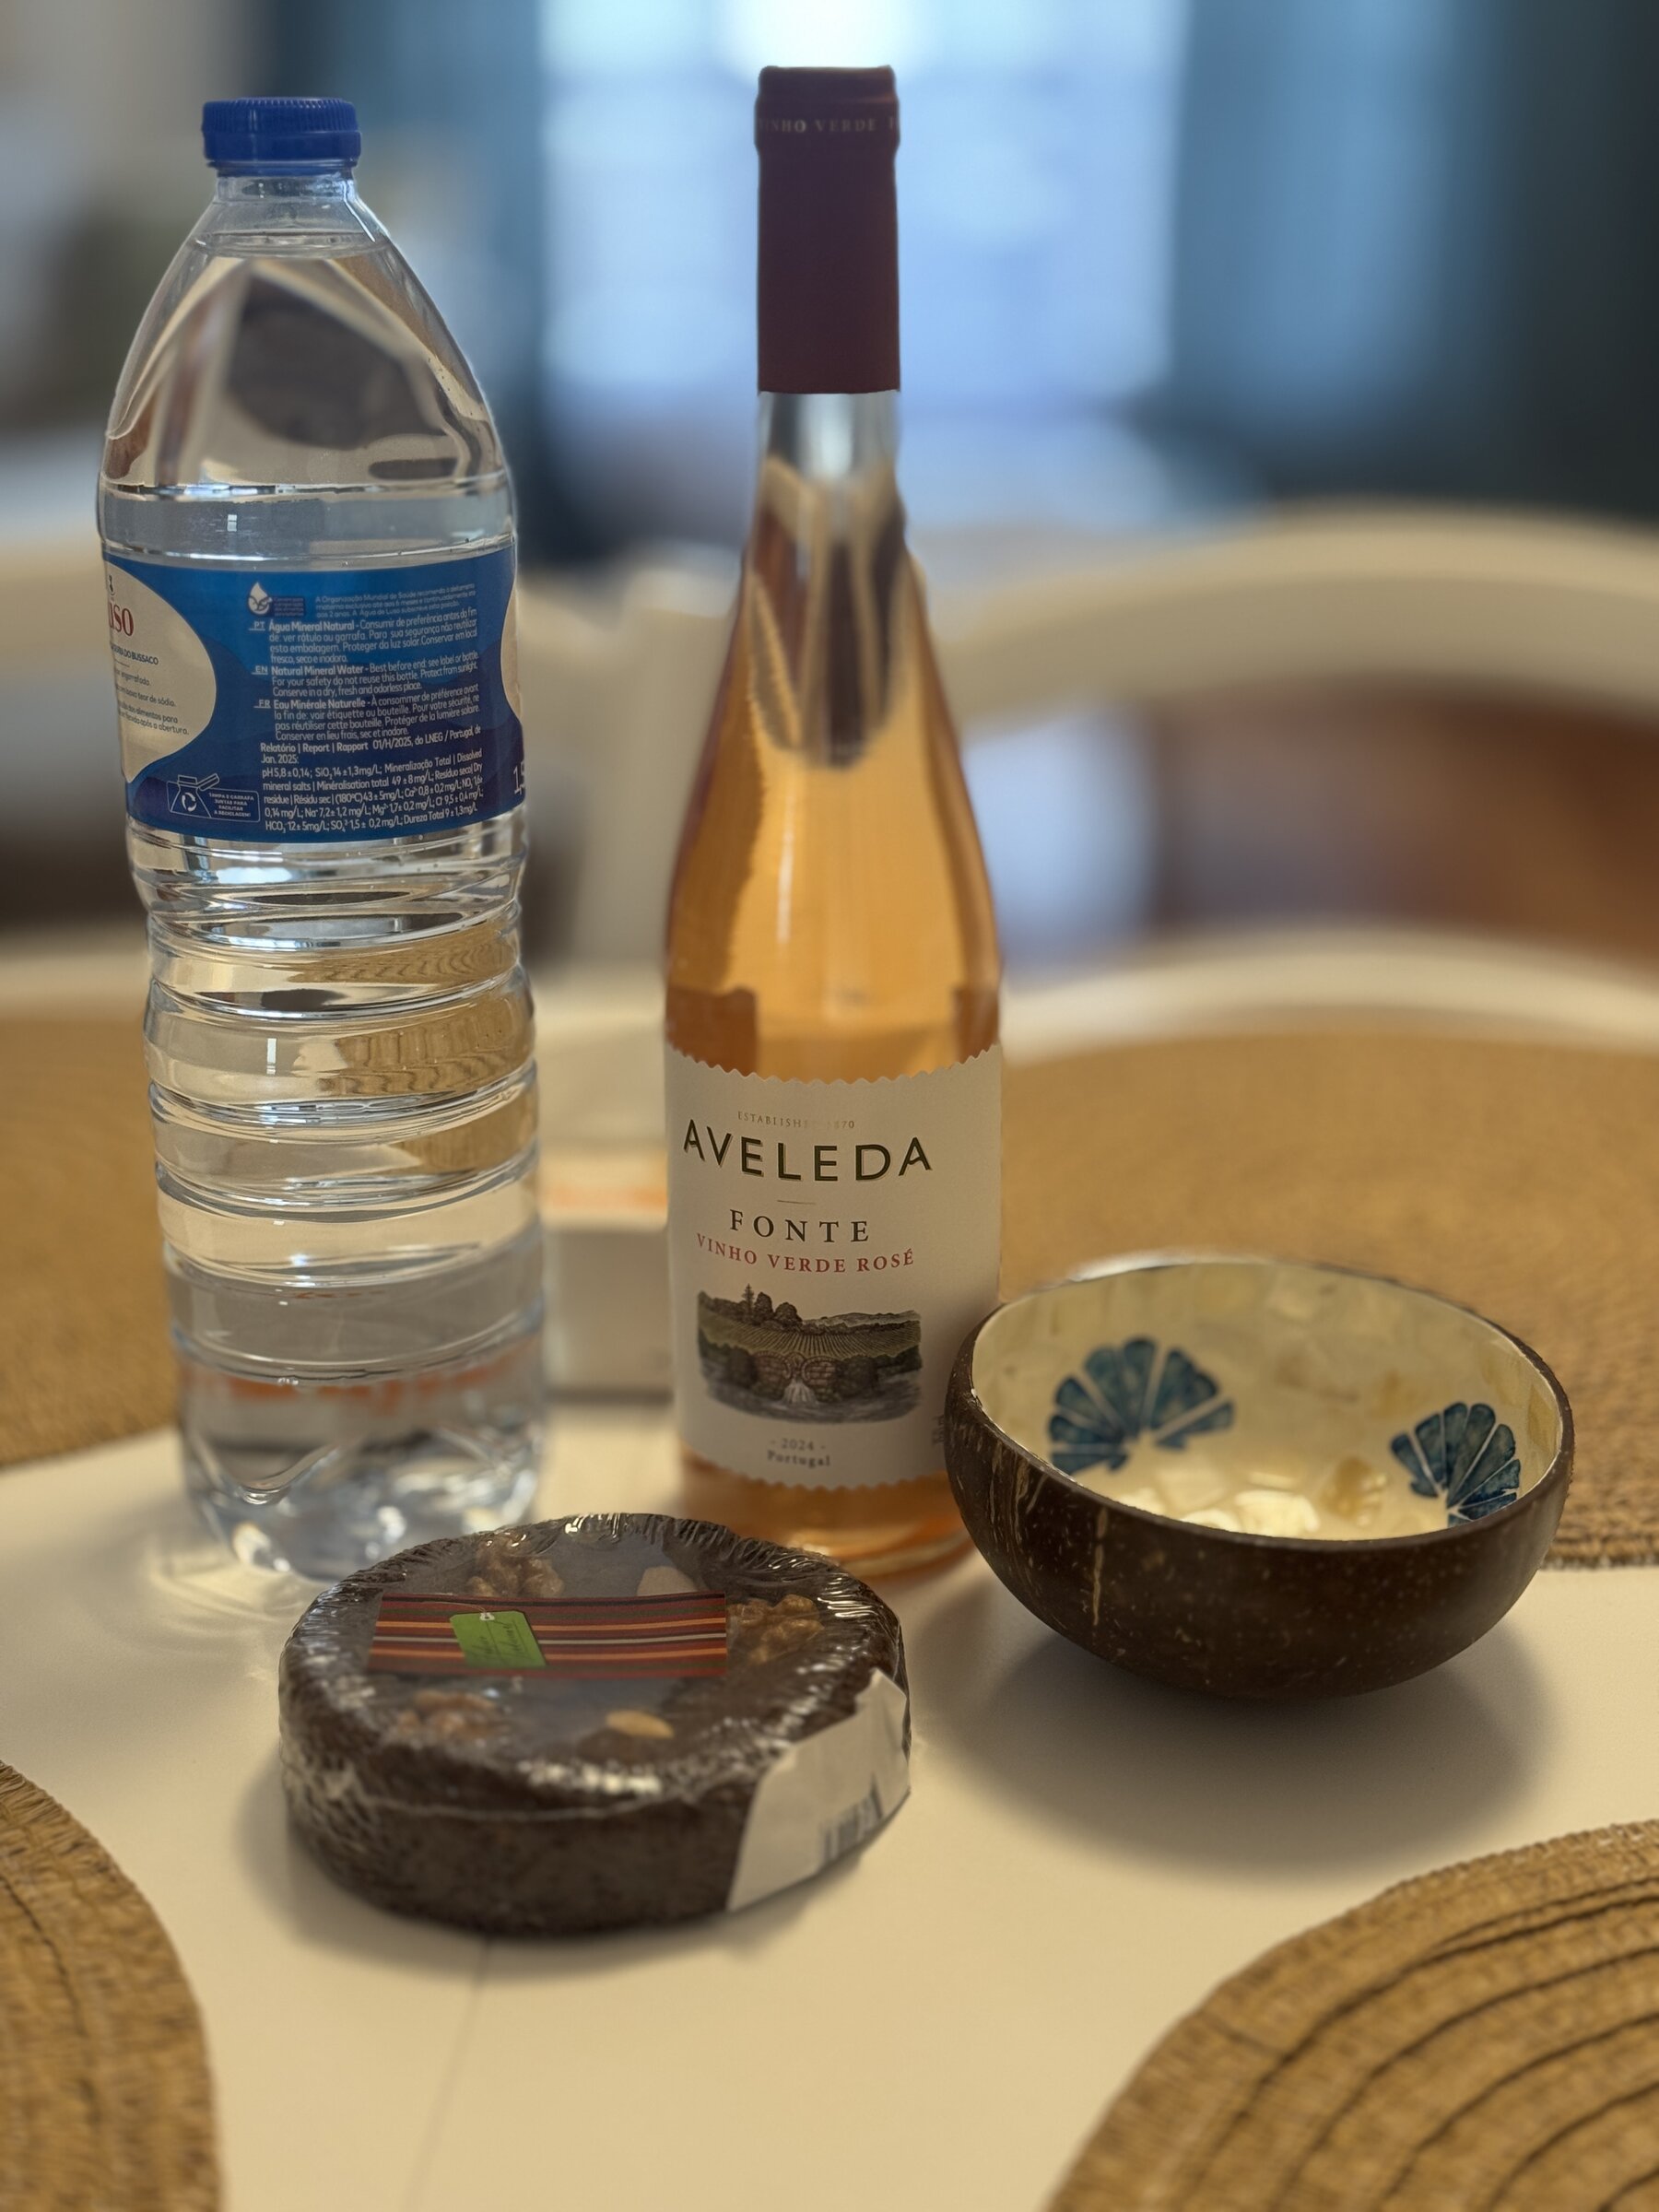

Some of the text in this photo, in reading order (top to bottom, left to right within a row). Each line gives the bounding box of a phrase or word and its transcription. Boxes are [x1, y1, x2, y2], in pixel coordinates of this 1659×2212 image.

[815, 118, 877, 132] VERDE
[109, 602, 134, 636] so
[269, 619, 290, 633] Água
[291, 620, 322, 631] Mineral
[323, 620, 354, 630] Natural
[360, 619, 394, 629] Consumir
[396, 617, 405, 627] de
[406, 614, 442, 627] preferência
[443, 612, 460, 620] antes
[298, 632, 322, 642] rótulo
[335, 630, 366, 643] garrafa.
[369, 629, 387, 639] Para
[390, 630, 403, 639] sua
[405, 626, 440, 637] segurança
[441, 623, 453, 632] não
[453, 618, 477, 630] reutilizar
[270, 645, 288, 653] esta
[290, 643, 341, 654] embalagem.
[342, 641, 377, 653] Proteger
[379, 640, 388, 649] da
[390, 638, 401, 648] luz
[421, 634, 454, 645] Conservar
[132, 652, 159, 665] BUSSACO
[271, 653, 295, 665] fresco,
[296, 655, 312, 663] seco
[319, 653, 348, 663] inodoro.
[271, 666, 303, 676] Natural
[304, 665, 336, 675] Mineral
[337, 664, 364, 674] Water
[370, 663, 387, 672] Best
[388, 660, 411, 671] before
[428, 658, 438, 666] see
[439, 655, 455, 665] label
[455, 656, 461, 664] or
[272, 676, 285, 686] For
[287, 678, 305, 688] your
[306, 677, 331, 688] safety
[333, 676, 343, 685] do
[344, 676, 358, 685] not
[359, 675, 380, 684] reuse
[382, 673, 395, 682] this
[396, 671, 419, 682] bottle.
[420, 668, 443, 679] Protect
[443, 666, 457, 675] from
[273, 687, 307, 697] Conserve
[308, 688, 316, 696] in
[323, 687, 337, 698] dry,
[338, 685, 357, 695] fresh
[358, 685, 372, 695] and
[374, 683, 402, 694] odorless
[403, 682, 423, 693] place.
[273, 700, 289, 709] Eau
[291, 699, 327, 709] Minérale
[328, 697, 365, 708] Naturelle
[371, 695, 377, 706] À
[378, 696, 420, 706] consommer
[421, 691, 429, 701] de
[431, 687, 463, 700] préférence
[463, 683, 479, 694] avant
[162, 712, 178, 724] para
[274, 710, 282, 720] la
[283, 709, 294, 720] fin
[296, 709, 308, 720] de:
[310, 710, 325, 719] voir
[327, 709, 364, 720] étiquette
[366, 709, 375, 717] ou
[377, 706, 411, 717] bouteille.
[412, 703, 429, 713] Pour
[430, 701, 447, 710] votre
[275, 721, 290, 731] pas
[292, 719, 325, 731] réutiliser
[327, 720, 348, 730] cette
[385, 715, 418, 726] Protéger
[419, 713, 428, 722] de
[429, 711, 435, 721] la
[436, 708, 460, 720] lumière
[158, 722, 189, 735] abertura.
[276, 731, 315, 741] Conserver
[316, 732, 326, 740] en
[326, 731, 339, 740] lieu
[340, 730, 359, 740] frais,
[373, 729, 381, 737] et
[381, 727, 409, 737] inodore.
[260, 742, 296, 753] Relatório
[302, 743, 330, 755] Report
[337, 742, 369, 754] Rapport
[373, 737, 414, 750] 01/H/2025,
[415, 735, 423, 745] do
[425, 732, 443, 745] LNEG
[474, 725, 481, 735] de
[261, 755, 277, 764] Jan.
[385, 748, 482, 773] Mineralização Total Dissolved
[263, 769, 459, 791] mineral salts Minéralisation total 49 Resíduo
[263, 794, 317, 804] residue Résidu
[404, 810, 444, 824] Dureza Total
[738, 1110, 813, 1129] ESTABLISHE
[683, 1119, 933, 1182] AVELEDA
[729, 1208, 870, 1243] FONTE
[696, 1232, 914, 1273] VINHO VERDE ROSÉ
[781, 1437, 814, 1451] 2024
[767, 1450, 831, 1469] Portugal
